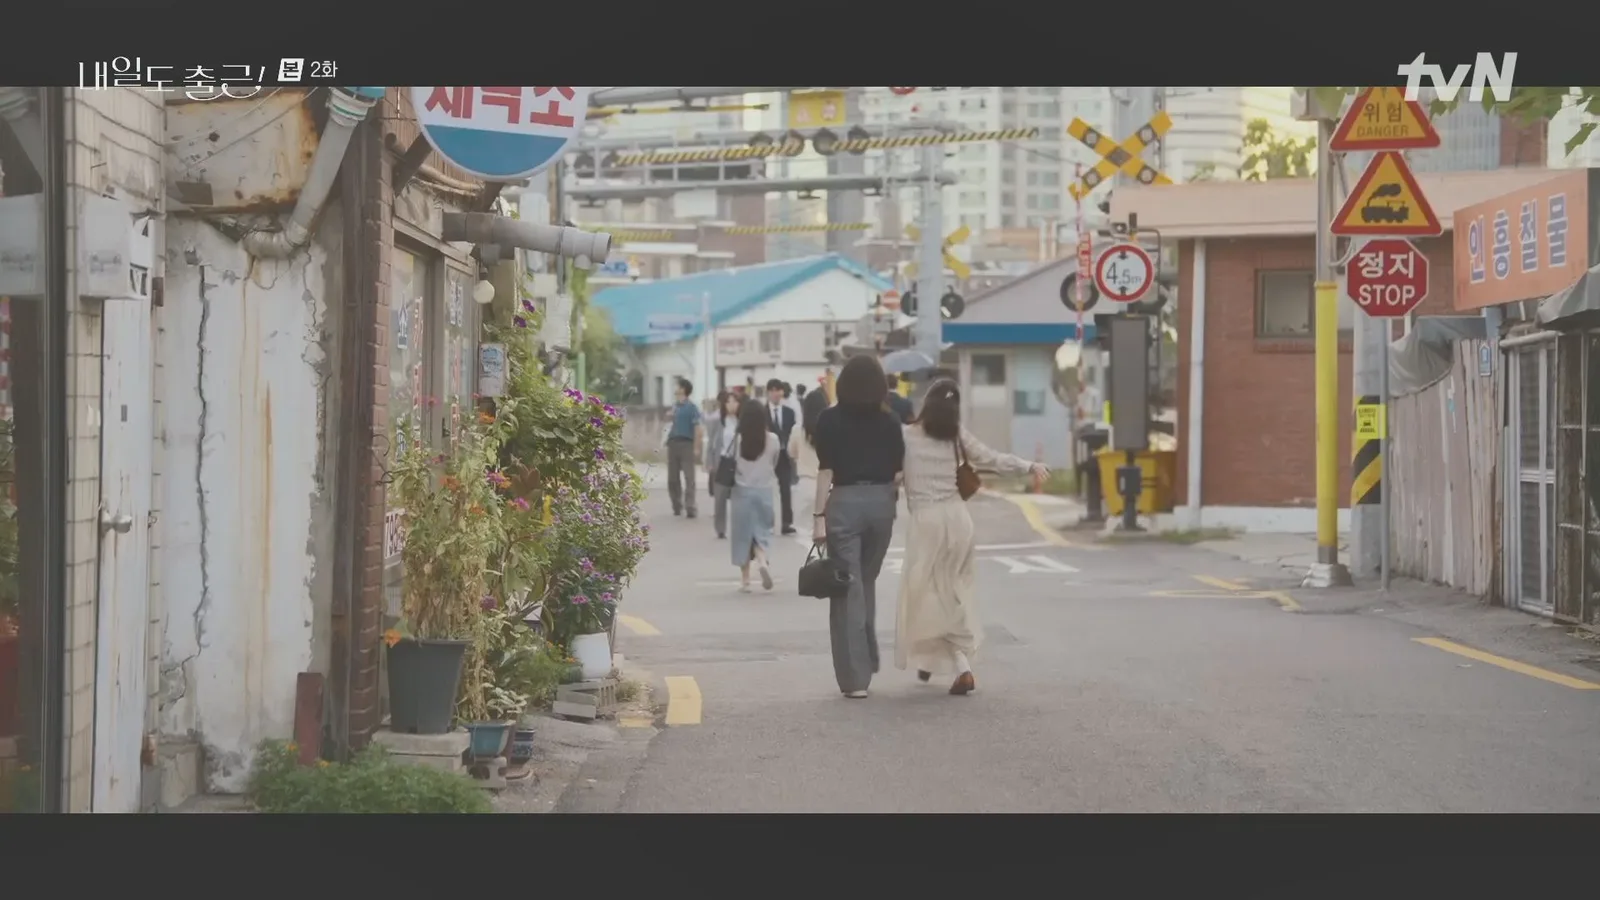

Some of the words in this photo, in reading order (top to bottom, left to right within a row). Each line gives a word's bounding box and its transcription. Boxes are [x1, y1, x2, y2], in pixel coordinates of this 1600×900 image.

[1363, 102, 1402, 123] 위험
[1356, 124, 1409, 138] DANGER
[1468, 192, 1569, 284] 인흥철물
[1106, 261, 1142, 285] 4.5m
[1357, 250, 1415, 279] 정지
[1358, 284, 1416, 306] STOP
